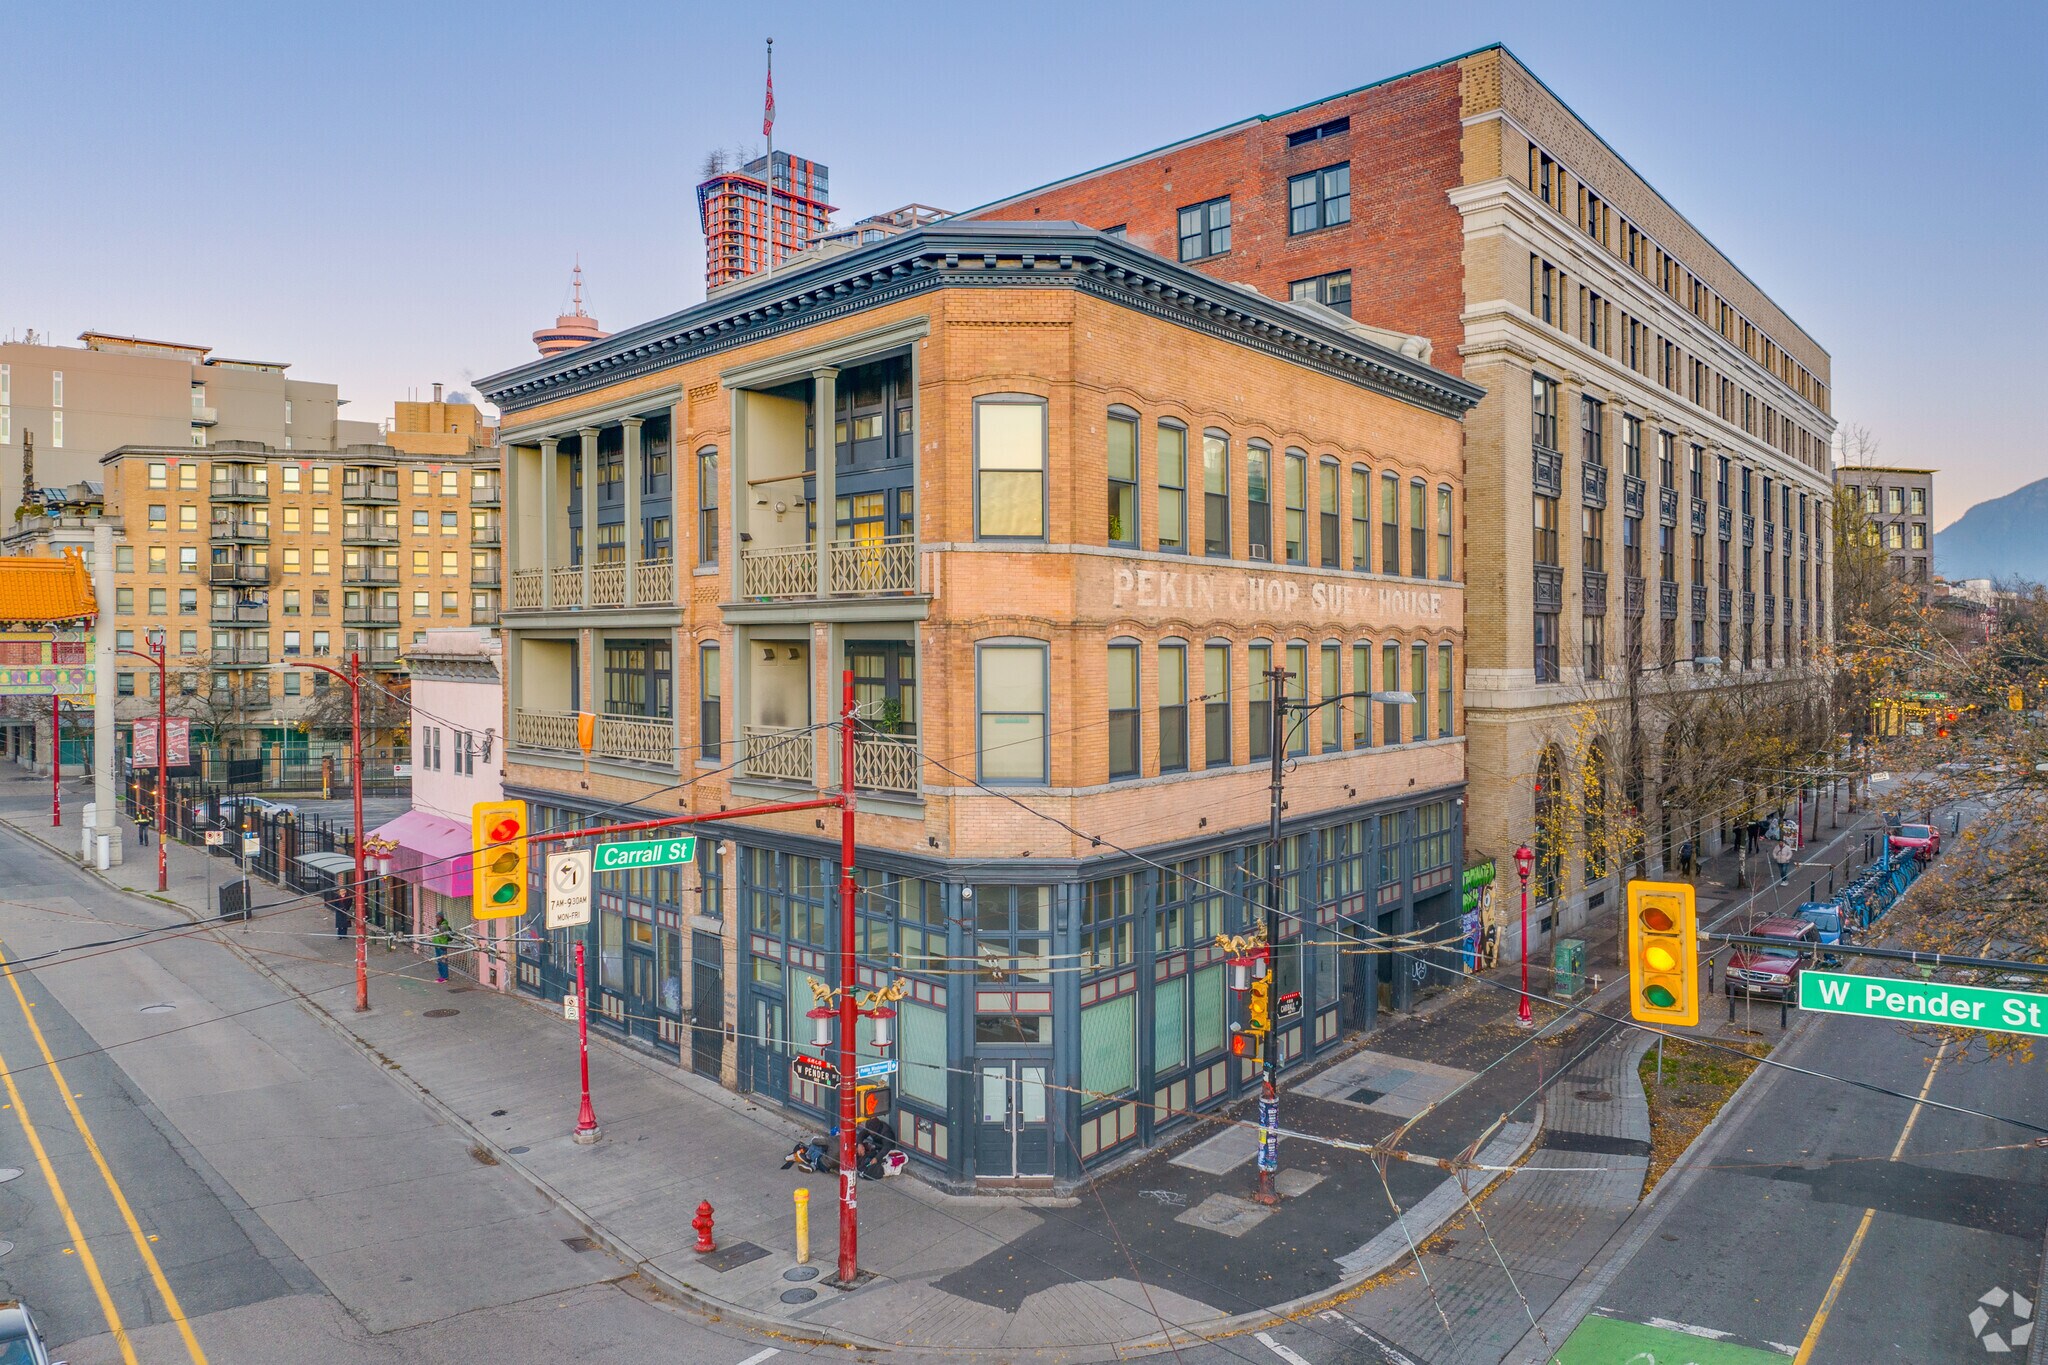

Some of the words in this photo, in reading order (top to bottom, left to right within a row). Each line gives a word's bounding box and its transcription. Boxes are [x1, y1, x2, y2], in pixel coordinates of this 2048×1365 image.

[1112, 568, 1215, 612] PEKIN
[1229, 577, 1299, 613] CHOP
[1378, 588, 1442, 619] HOUSE
[604, 845, 662, 866] Carrall
[668, 842, 687, 861] St
[557, 912, 580, 921] MON-FRI
[1818, 979, 1850, 1006] W
[1865, 984, 1985, 1020] Pender
[2002, 998, 2041, 1028] St
[804, 1066, 830, 1081] PENDER
